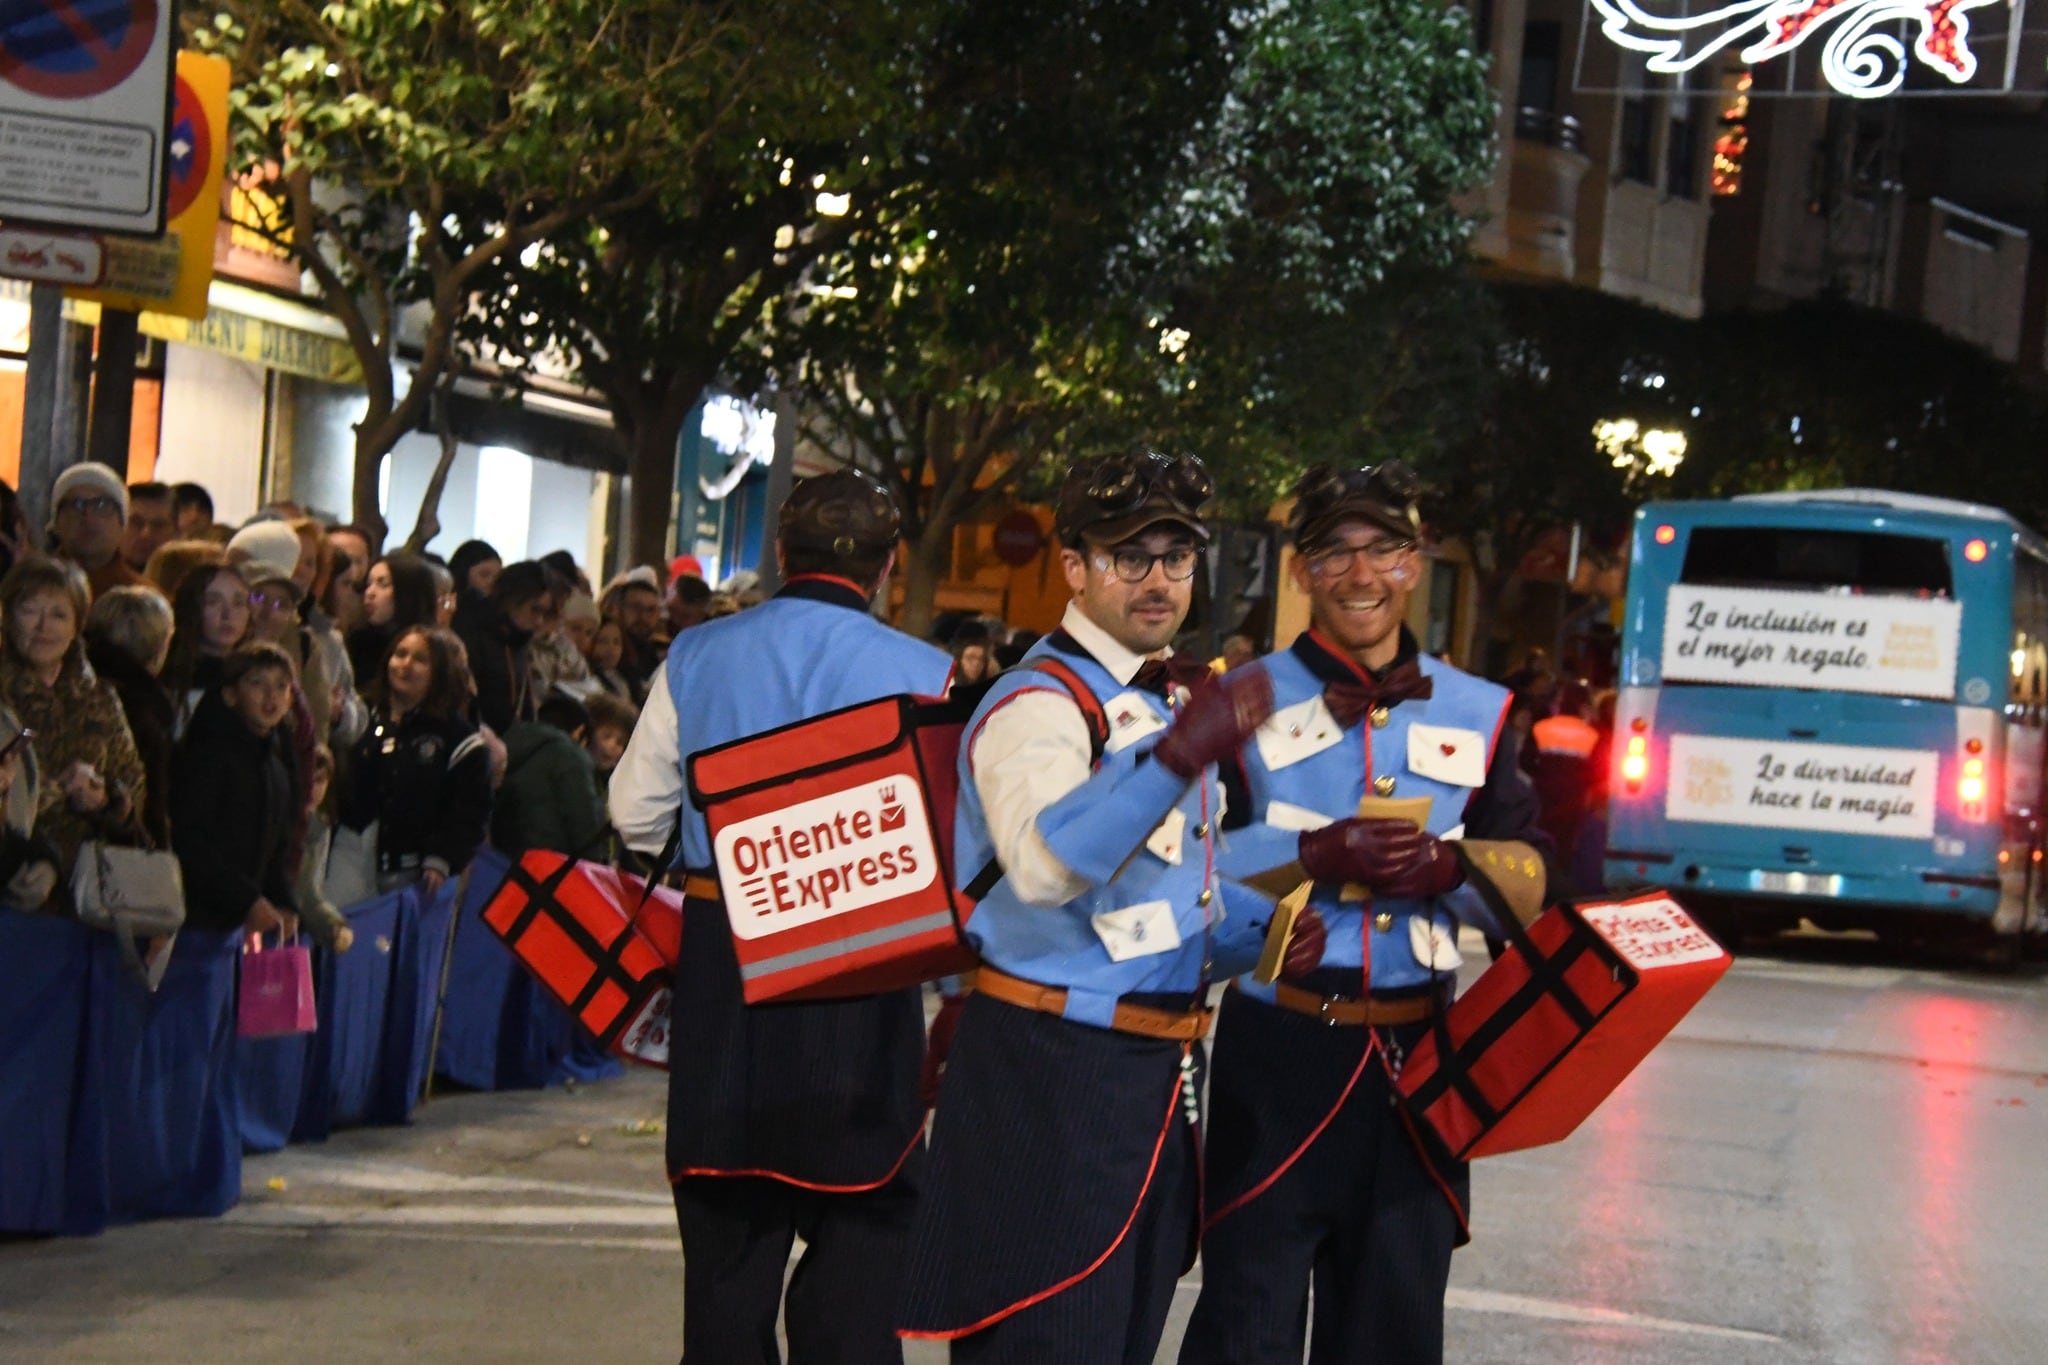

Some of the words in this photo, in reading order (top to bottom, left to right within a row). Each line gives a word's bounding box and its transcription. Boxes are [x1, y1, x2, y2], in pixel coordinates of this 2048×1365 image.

[1685, 601, 1718, 632] La
[1725, 605, 1835, 635] inclusión
[1845, 618, 1868, 638] es
[1677, 637, 1697, 656] el
[1705, 639, 1774, 668] mejor
[1757, 753, 1786, 782] La
[1793, 759, 1916, 787] diversidad
[1750, 786, 1800, 809] hace
[1810, 789, 1832, 810] la
[732, 809, 872, 876] Oriente
[771, 844, 918, 914] Express
